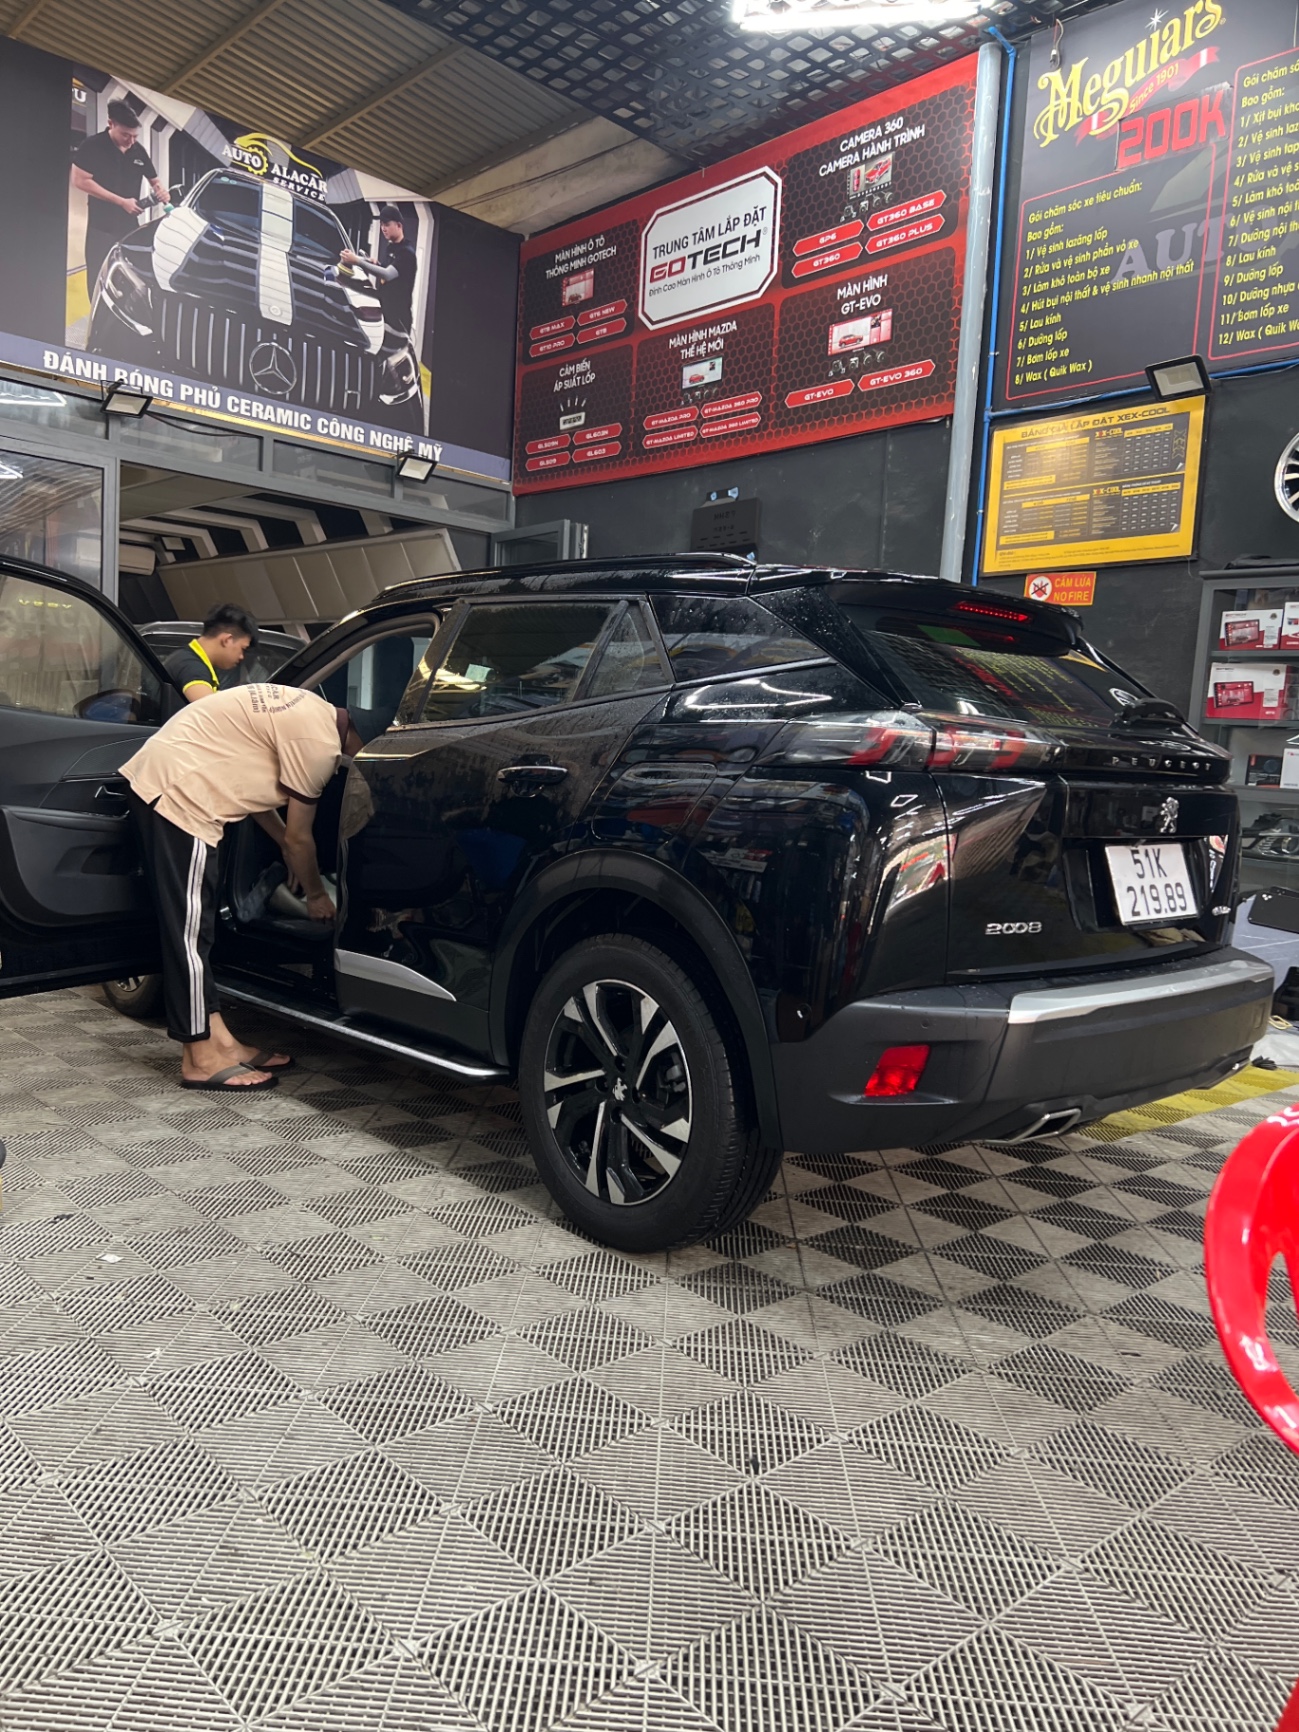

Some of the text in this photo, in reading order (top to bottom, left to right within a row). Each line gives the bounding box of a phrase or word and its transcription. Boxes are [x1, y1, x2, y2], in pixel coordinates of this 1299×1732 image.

[1130, 63, 1178, 113] Since 1901
[1243, 73, 1259, 88] Gói
[1261, 66, 1287, 82] chăm
[1242, 96, 1259, 107] Bao
[1117, 89, 1226, 169] 200K
[1241, 106, 1282, 128] 1/ bụi
[840, 116, 903, 152] CAMERA 360
[1238, 127, 1283, 147] 2/ Vệ sinh
[222, 144, 261, 167] AUTO
[819, 124, 925, 177] CAMERA HÀNH TRÌNH
[1236, 146, 1281, 167] 3/ Vệ sinh
[1234, 162, 1292, 187] 4/ Rửa và vệ
[273, 177, 325, 201] SERVICE
[1232, 194, 1242, 207] 5/
[877, 198, 935, 224] GT360 BASE
[1029, 211, 1042, 224] Gói
[1044, 203, 1065, 219] chăm
[1068, 198, 1082, 212] sóc
[1084, 196, 1094, 207] xe
[1096, 190, 1111, 204] tiêu
[1230, 200, 1292, 227] 6/ Vệ sinh nội
[653, 205, 767, 259] TRUNG TÂM LẮP ĐẶT
[876, 223, 933, 247] GT360 PLUS
[1026, 226, 1108, 260] 1/ Vệ sinh lốp
[1027, 231, 1041, 242] Bao
[1228, 221, 1287, 246] 7/ nội
[555, 235, 605, 263] MÀN HÌNH Ô TÔ
[650, 229, 761, 284] GOTECH
[813, 253, 840, 267] GT360
[1024, 265, 1033, 279] 2/
[1051, 258, 1061, 270] và
[1064, 255, 1073, 267] vệ
[1075, 250, 1090, 266] sinh
[1116, 240, 1126, 253] vỏ
[1128, 240, 1139, 249] xe
[1226, 246, 1276, 266] 8/ Lau kính
[546, 245, 616, 279] THÔNG MINH GOTECH
[663, 283, 676, 292] Cao
[744, 254, 760, 265] Minh
[1224, 262, 1283, 286] 9/ lốp
[837, 274, 887, 300] MÀN HÌNH
[1021, 259, 1194, 314] 4/ Hút bụi nội thất & vệ sinh nhanh nội thất
[1022, 265, 1110, 296] 3/ khô toàn bộ xe
[841, 294, 881, 315] GT-EVO
[1223, 282, 1295, 306] 10/ nhựa
[1019, 310, 1061, 332] 5/ Lau kính
[1221, 303, 1289, 325] 11/ Bơm lốp xe
[669, 320, 738, 349] MÀN HÌNH MAZDA
[1018, 327, 1067, 349] 6/ lốp
[1219, 321, 1286, 344] 12/ Wax Quik
[681, 338, 724, 359] THẾ HỆ MỚI
[1017, 347, 1069, 367] 7/ lốp xe
[553, 371, 596, 392] ÁP SUẤT LỐP
[559, 364, 575, 377] CẢM
[870, 367, 923, 386] GT-EVO 360
[1015, 361, 1086, 385] 8/ Wax Quik Wax
[43, 350, 107, 381] ĐÁNH
[115, 368, 173, 398] BÓNG
[180, 386, 220, 408] PHỦ
[227, 395, 312, 430] CERAMIC
[317, 418, 364, 443] CÔNG
[804, 389, 834, 400] GT-EVO
[1055, 577, 1072, 587] CẤM
[1054, 591, 1089, 601] NO FIRE
[1130, 847, 1167, 879] 51K
[1127, 882, 1188, 916] 219.89
[985, 922, 1042, 935] 2008
